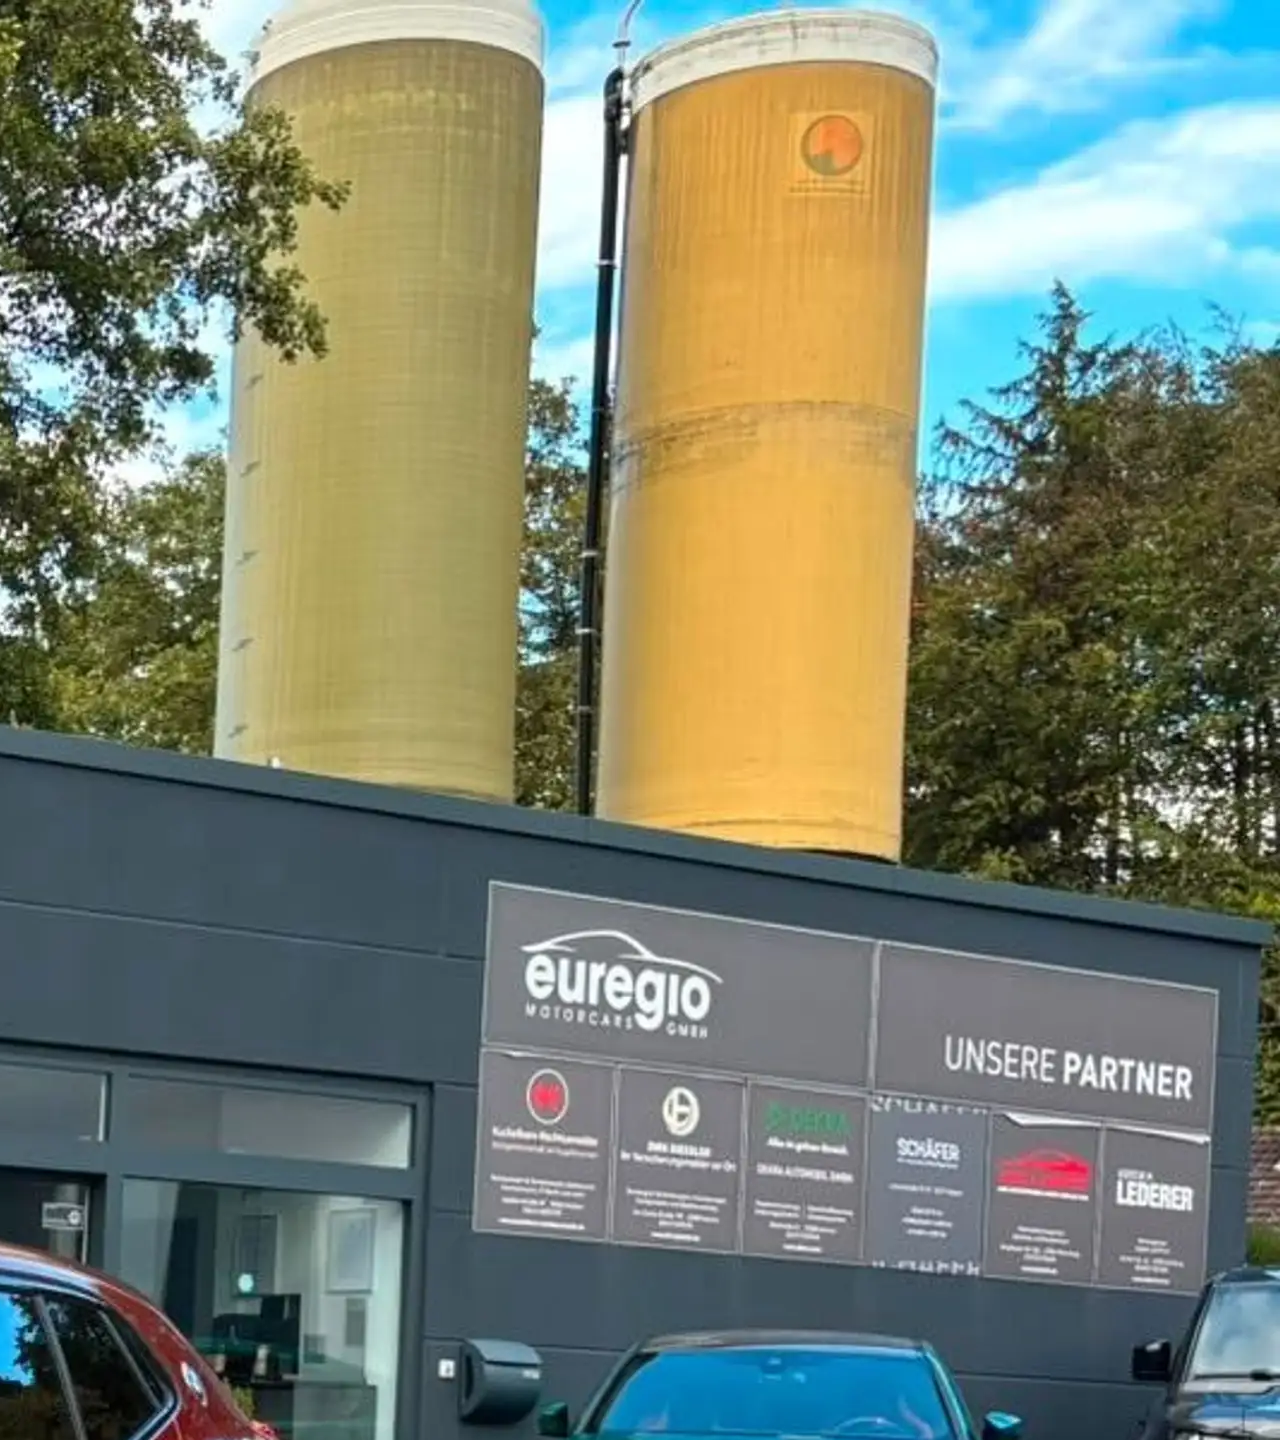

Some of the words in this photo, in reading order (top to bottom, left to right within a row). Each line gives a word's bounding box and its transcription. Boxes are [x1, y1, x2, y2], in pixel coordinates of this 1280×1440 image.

[525, 954, 710, 1031] euregio
[525, 1001, 634, 1030] MOTORCARS
[666, 1021, 708, 1039] GMBH
[944, 1034, 1057, 1083] UNSERE
[1063, 1050, 1193, 1101] PARTNER
[896, 1136, 960, 1162] SCHÄFER
[1116, 1179, 1194, 1211] LEDERER
